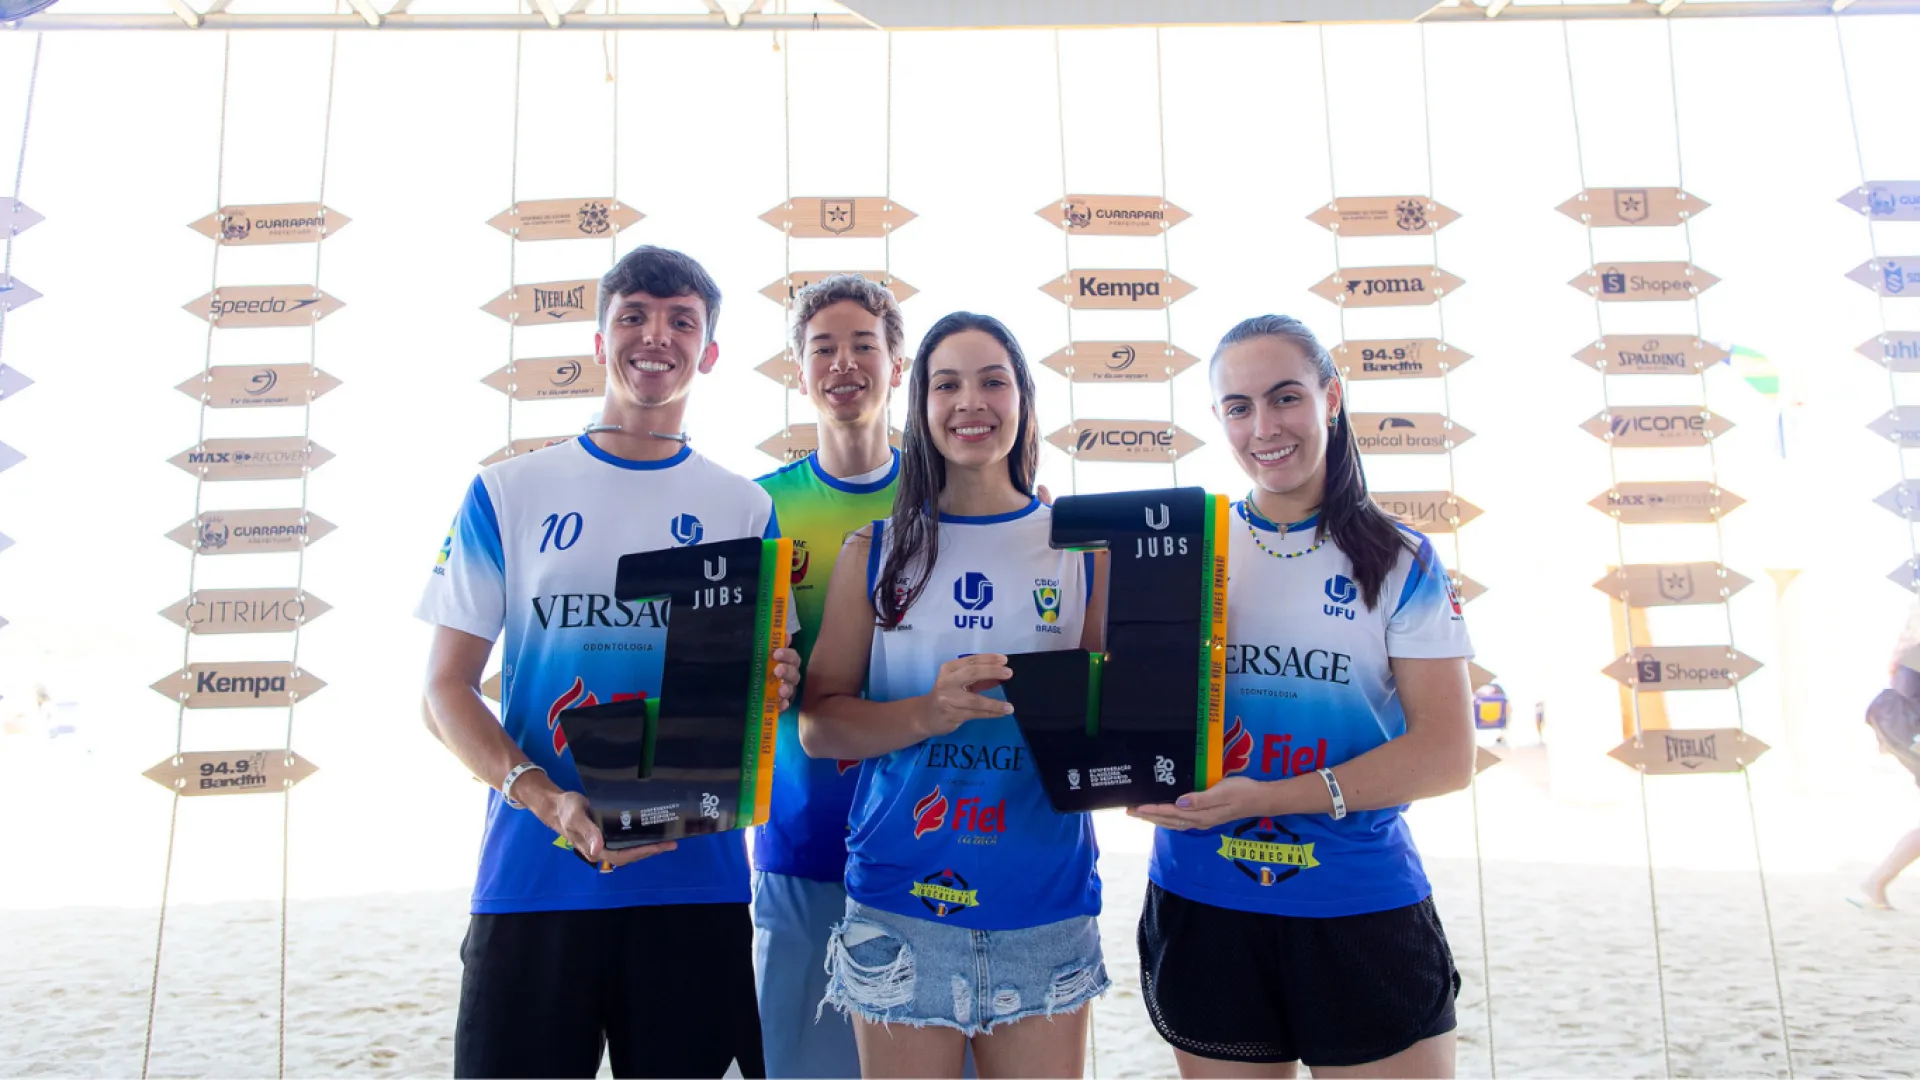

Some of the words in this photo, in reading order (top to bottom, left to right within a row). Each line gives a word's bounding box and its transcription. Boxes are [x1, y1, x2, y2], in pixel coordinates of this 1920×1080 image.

[255, 217, 325, 229] GUARAPARI
[1096, 209, 1164, 219] GUARAPARI
[1079, 277, 1160, 301] Kempa
[1630, 276, 1692, 294] Shopee
[209, 296, 286, 317] speedo
[534, 286, 585, 313] EVERLAST
[1361, 348, 1406, 361] 94.9
[1618, 351, 1686, 368] SPALDING
[1357, 432, 1403, 448] opical
[188, 452, 230, 463] MAX
[233, 525, 307, 537] GUARAPARI
[540, 511, 583, 553] 10
[1135, 536, 1188, 558] JUBS
[692, 586, 742, 610] JUBS
[185, 600, 305, 624] CITRINO
[532, 593, 671, 631] VERSA
[1323, 604, 1355, 621] UFU
[954, 615, 994, 630] UFU
[583, 643, 653, 652] ODONTOLOGIA
[1223, 644, 1351, 685] ERSAGE
[1667, 664, 1731, 684] Shopee
[196, 671, 285, 698] Kempa
[1240, 687, 1298, 698] ODONTOLOGIA
[1261, 733, 1328, 777] Fiel
[1664, 735, 1718, 762] EVERLAST
[200, 760, 249, 777] 94.9
[200, 774, 266, 790] Bandfm
[952, 797, 1006, 833] Fiel
[1231, 847, 1304, 864] BUCHECHA
